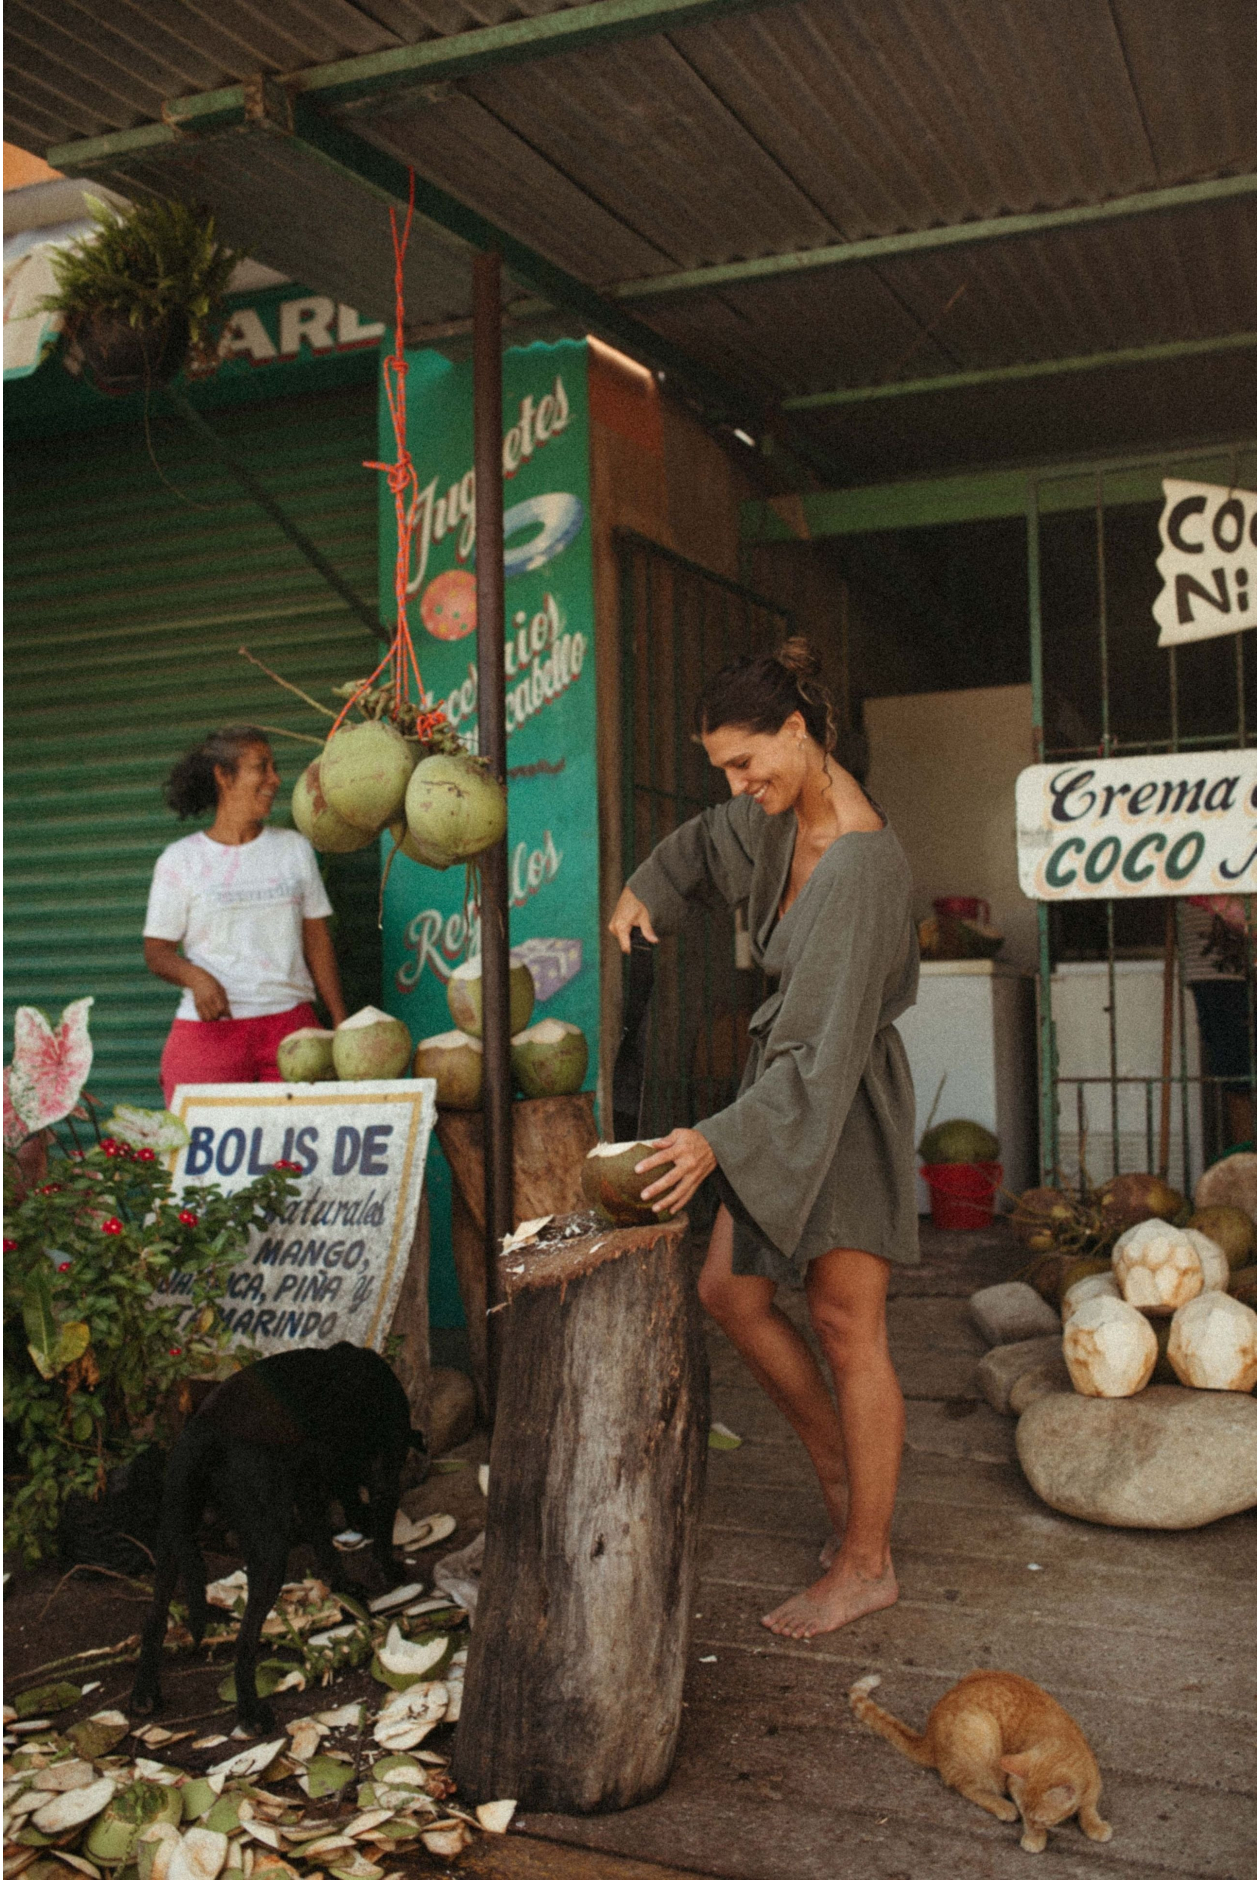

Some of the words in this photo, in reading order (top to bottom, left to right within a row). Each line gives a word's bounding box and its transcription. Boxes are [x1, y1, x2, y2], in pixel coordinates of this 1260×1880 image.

[404, 374, 571, 594] Jugetes
[1167, 495, 1257, 554] CO
[1174, 567, 1249, 626] Ni
[1049, 767, 1242, 823] Crema
[1045, 832, 1206, 888] COCO
[184, 1126, 319, 1176] BOLIS
[332, 1124, 394, 1176] DE
[252, 1241, 370, 1274] MANGO,
[155, 1269, 266, 1305] JAICA,
[274, 1269, 343, 1303] PIÑA
